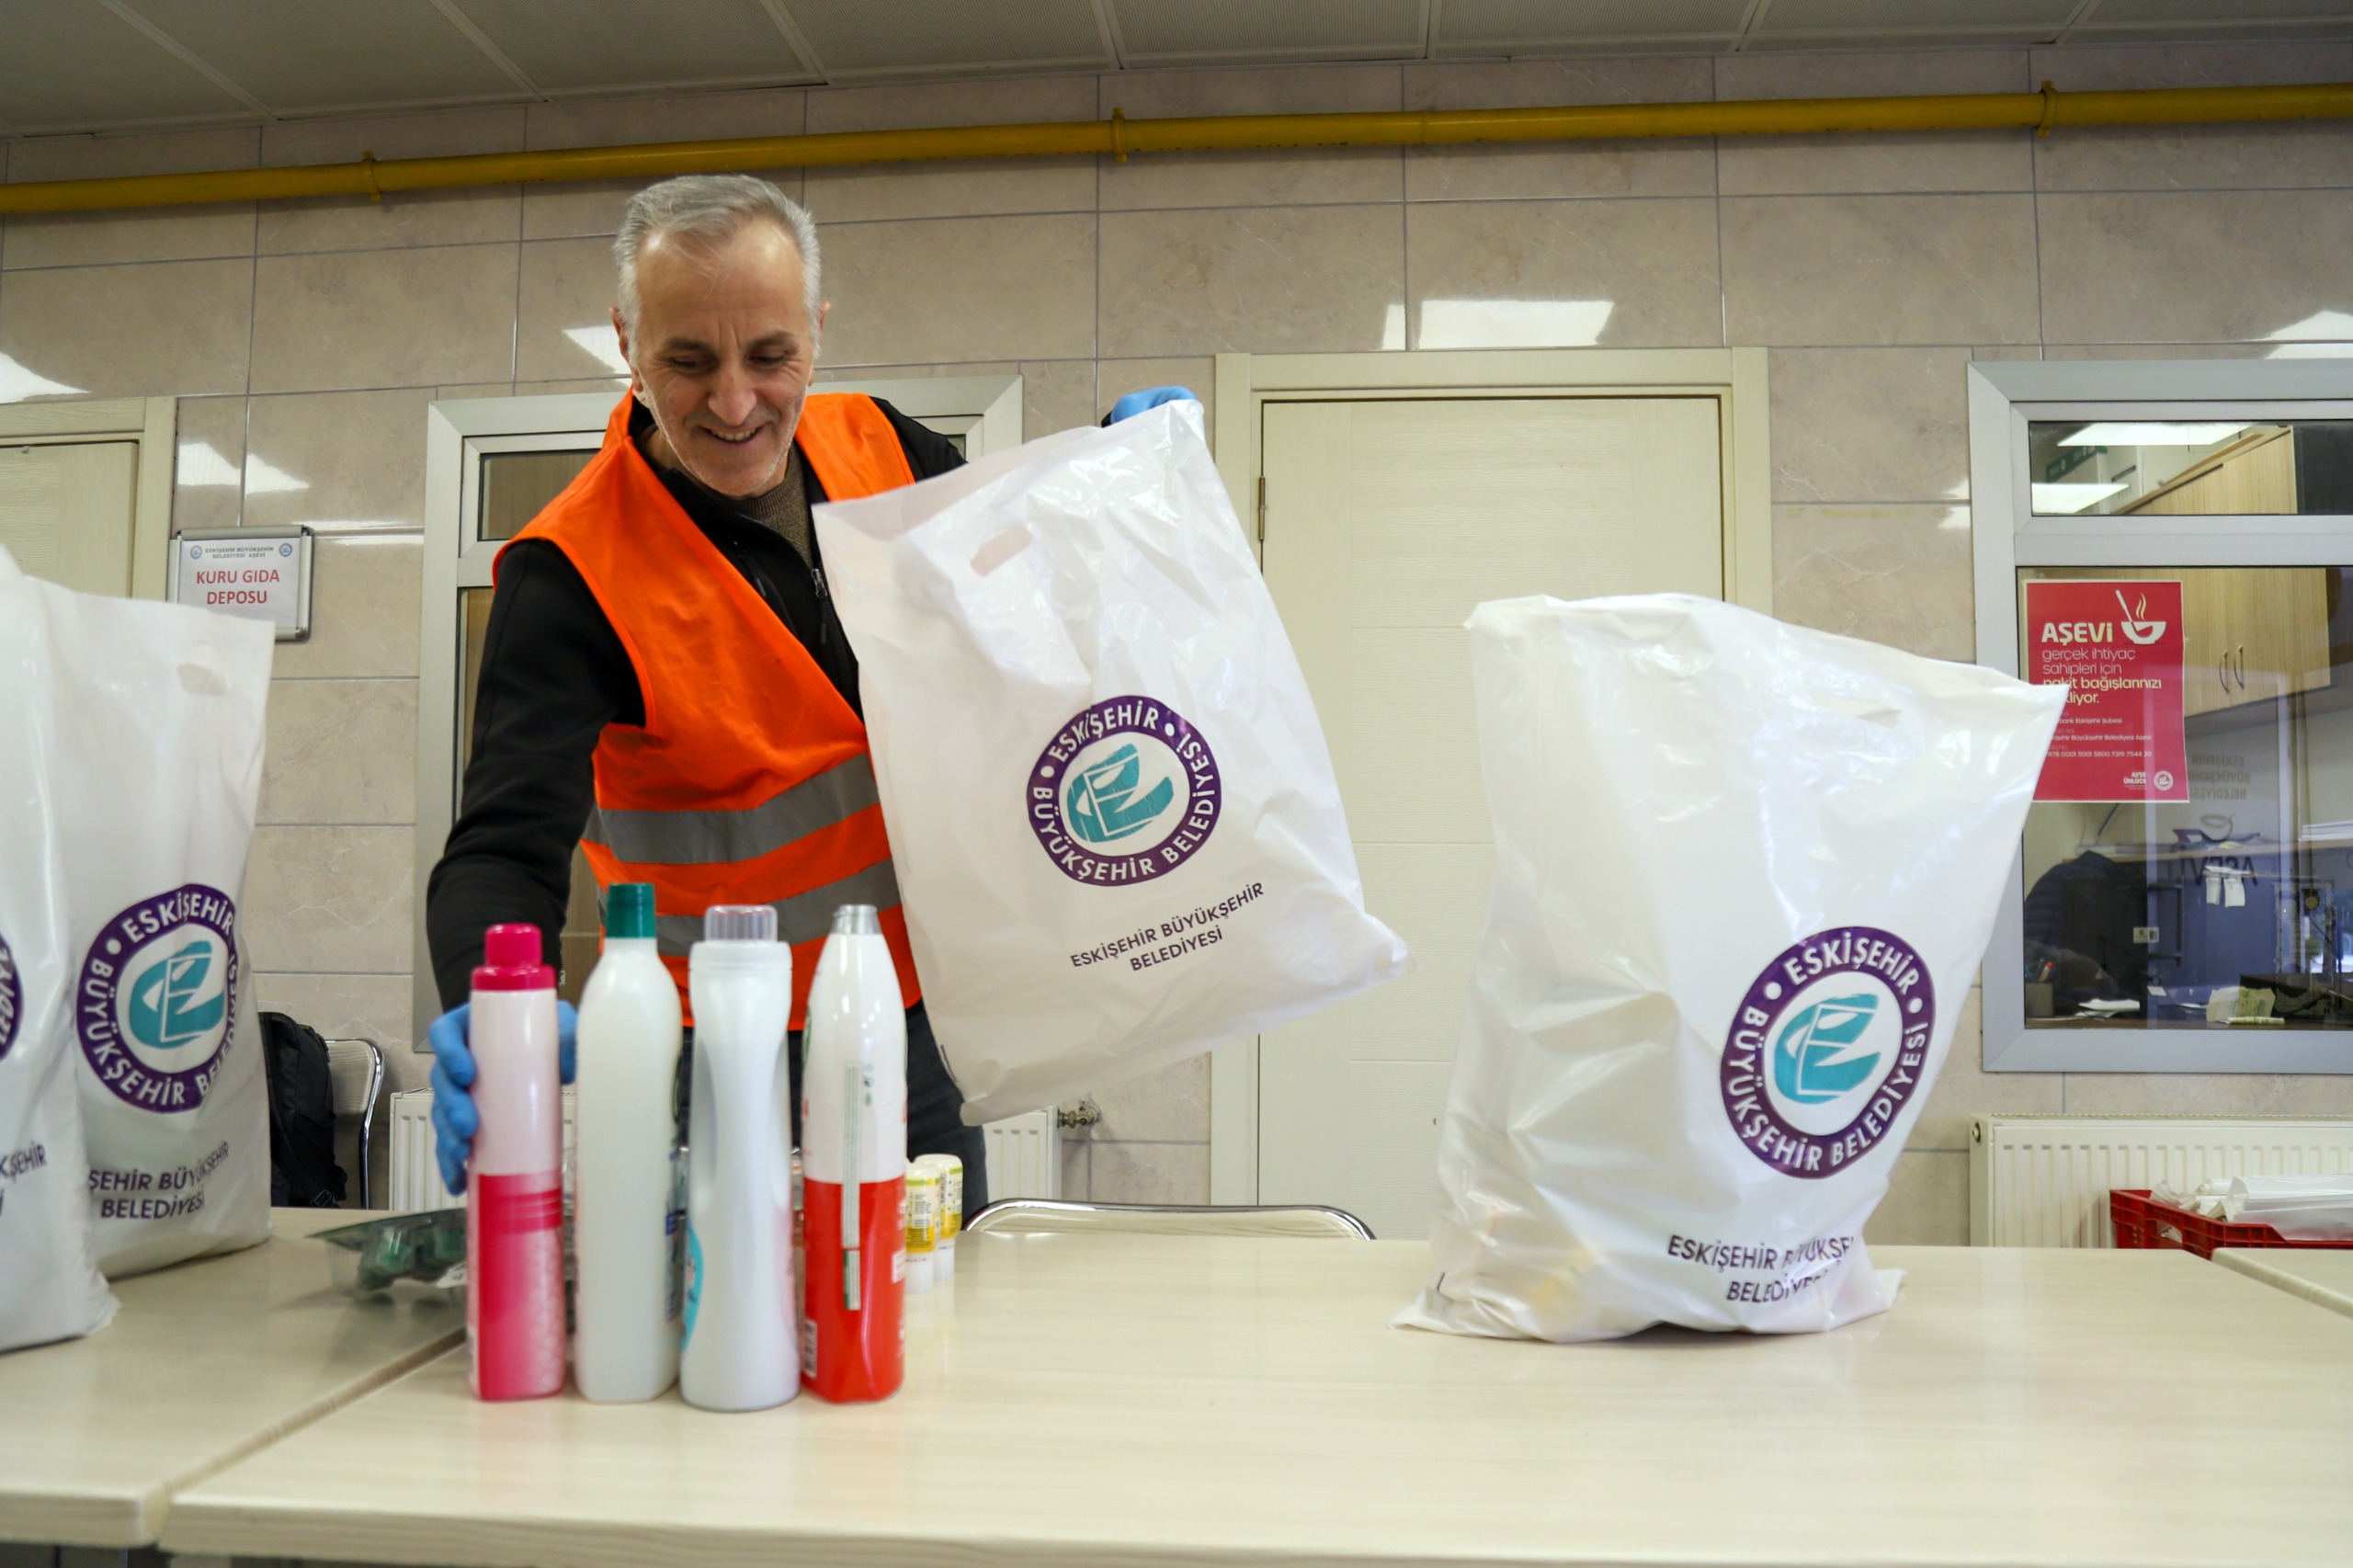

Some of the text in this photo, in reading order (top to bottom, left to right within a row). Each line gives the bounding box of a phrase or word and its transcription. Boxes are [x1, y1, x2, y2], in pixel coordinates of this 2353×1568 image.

[197, 569, 279, 585] KURU GIDA
[207, 590, 267, 604] DEPOSU
[2041, 647, 2136, 664] gerçek ihtiyaç
[2042, 662, 2122, 676] sahipleri için
[1049, 699, 1160, 764] ESKİŞEHİR
[1160, 733, 1216, 865] BELEDİYESİ
[1032, 786, 1157, 881] BÜYÜKŞEHİR
[121, 892, 233, 943] ESKİŞEHİR
[1070, 881, 1265, 967] ESKİŞEHİR BÜYÜKŞEHİR
[1130, 925, 1224, 971] BELEDİYESİ
[1784, 932, 1920, 995] ESKİŞEHİR
[85, 960, 185, 1106] BÜYÜKŞEHİR
[1729, 1005, 1824, 1173] BÜYÜKŞEHİR
[1829, 1019, 1929, 1168] BELEDİYESİ
[89, 1141, 230, 1195] ŞEHİR BÜYÜKŞEHİR
[100, 1190, 205, 1220] BELEDİYESİ
[1668, 1233, 1779, 1272] ESKİŞEHİR
